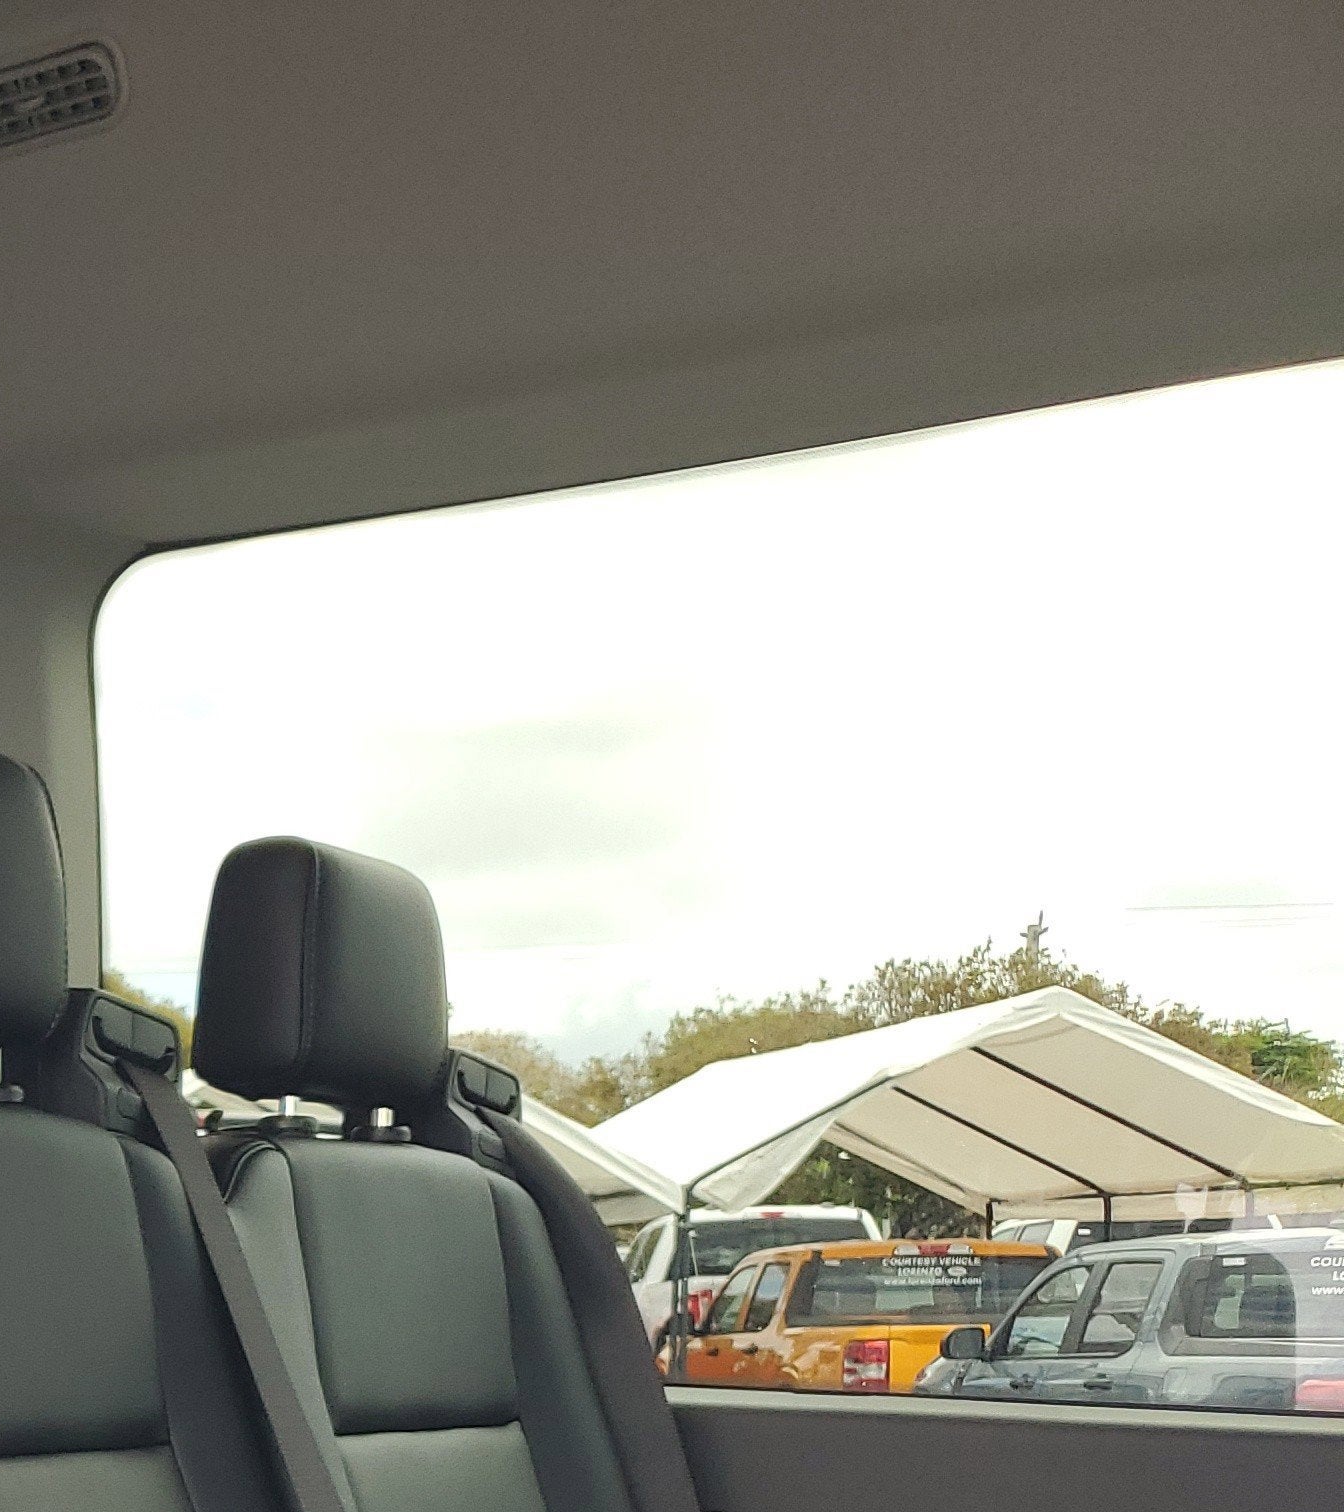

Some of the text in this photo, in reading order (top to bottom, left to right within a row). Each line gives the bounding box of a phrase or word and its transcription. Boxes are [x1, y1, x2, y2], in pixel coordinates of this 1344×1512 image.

[882, 1256, 982, 1267] COURTESY VEHICLE
[1310, 1256, 1344, 1267] COU
